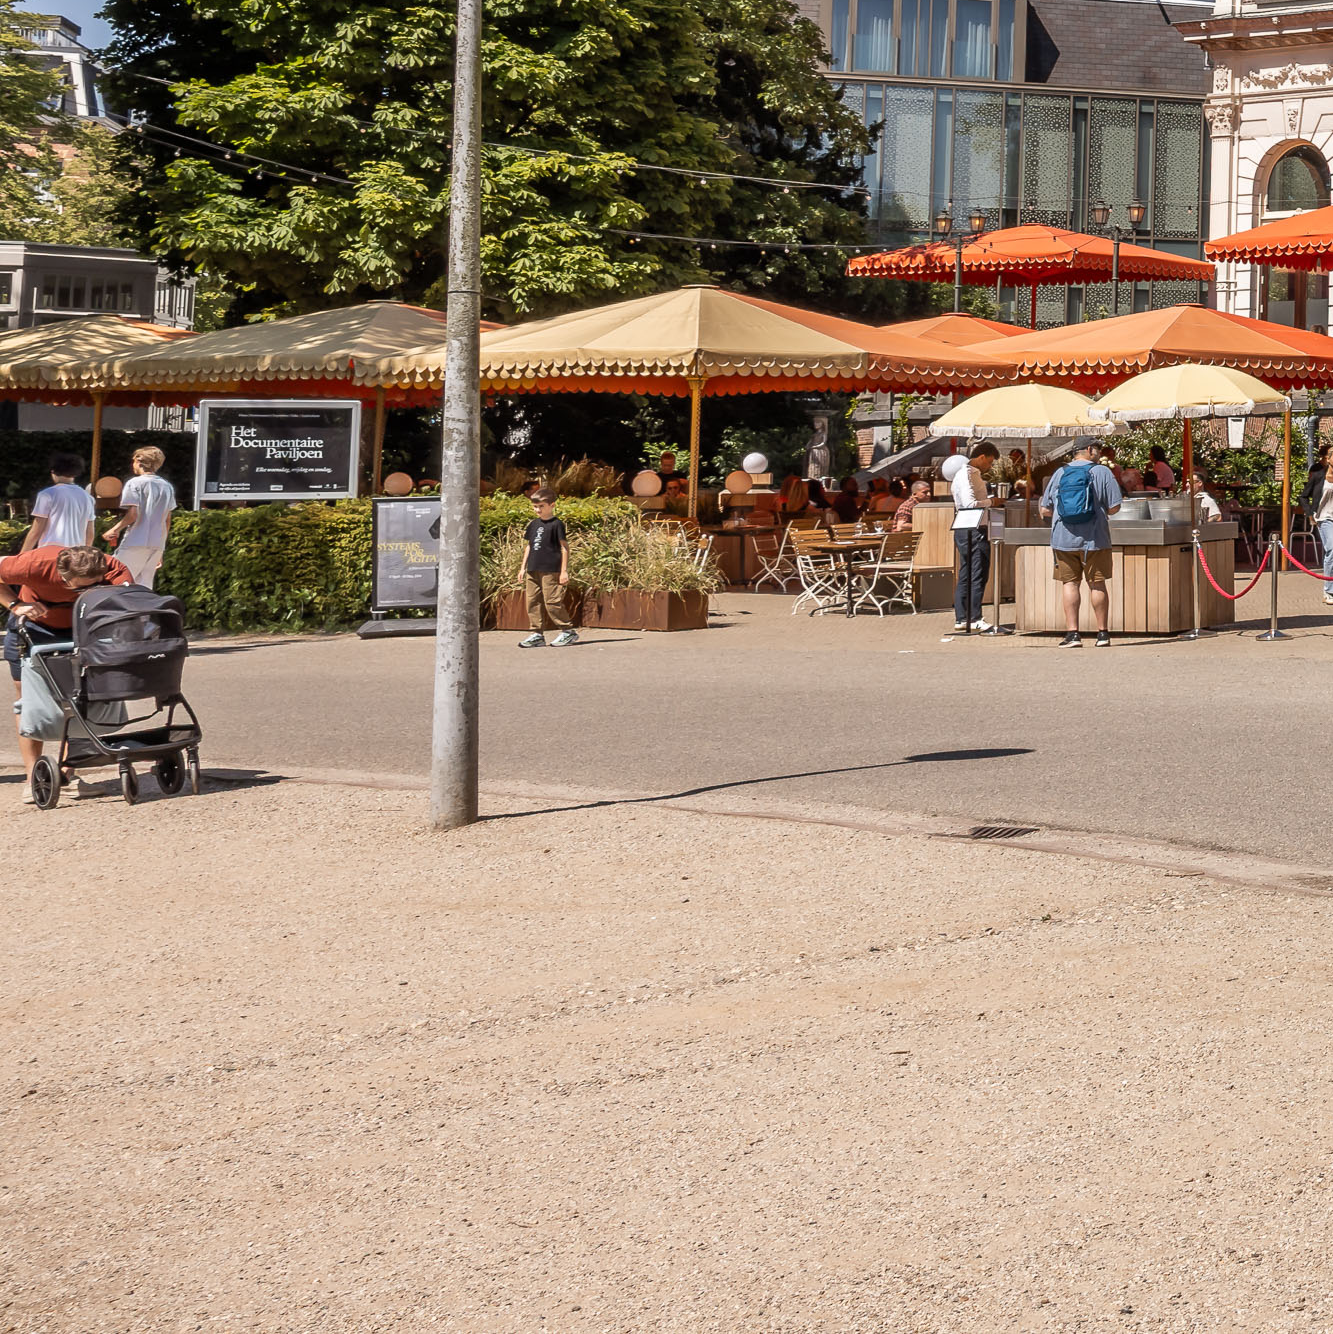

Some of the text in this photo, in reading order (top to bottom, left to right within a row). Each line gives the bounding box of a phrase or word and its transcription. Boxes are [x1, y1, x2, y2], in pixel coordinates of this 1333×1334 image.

[230, 425, 257, 437] Het
[230, 436, 324, 448] Documentaire
[265, 447, 323, 461] Paviljoen
[377, 542, 420, 551] SYSTEMS
[404, 548, 424, 557] FOR
